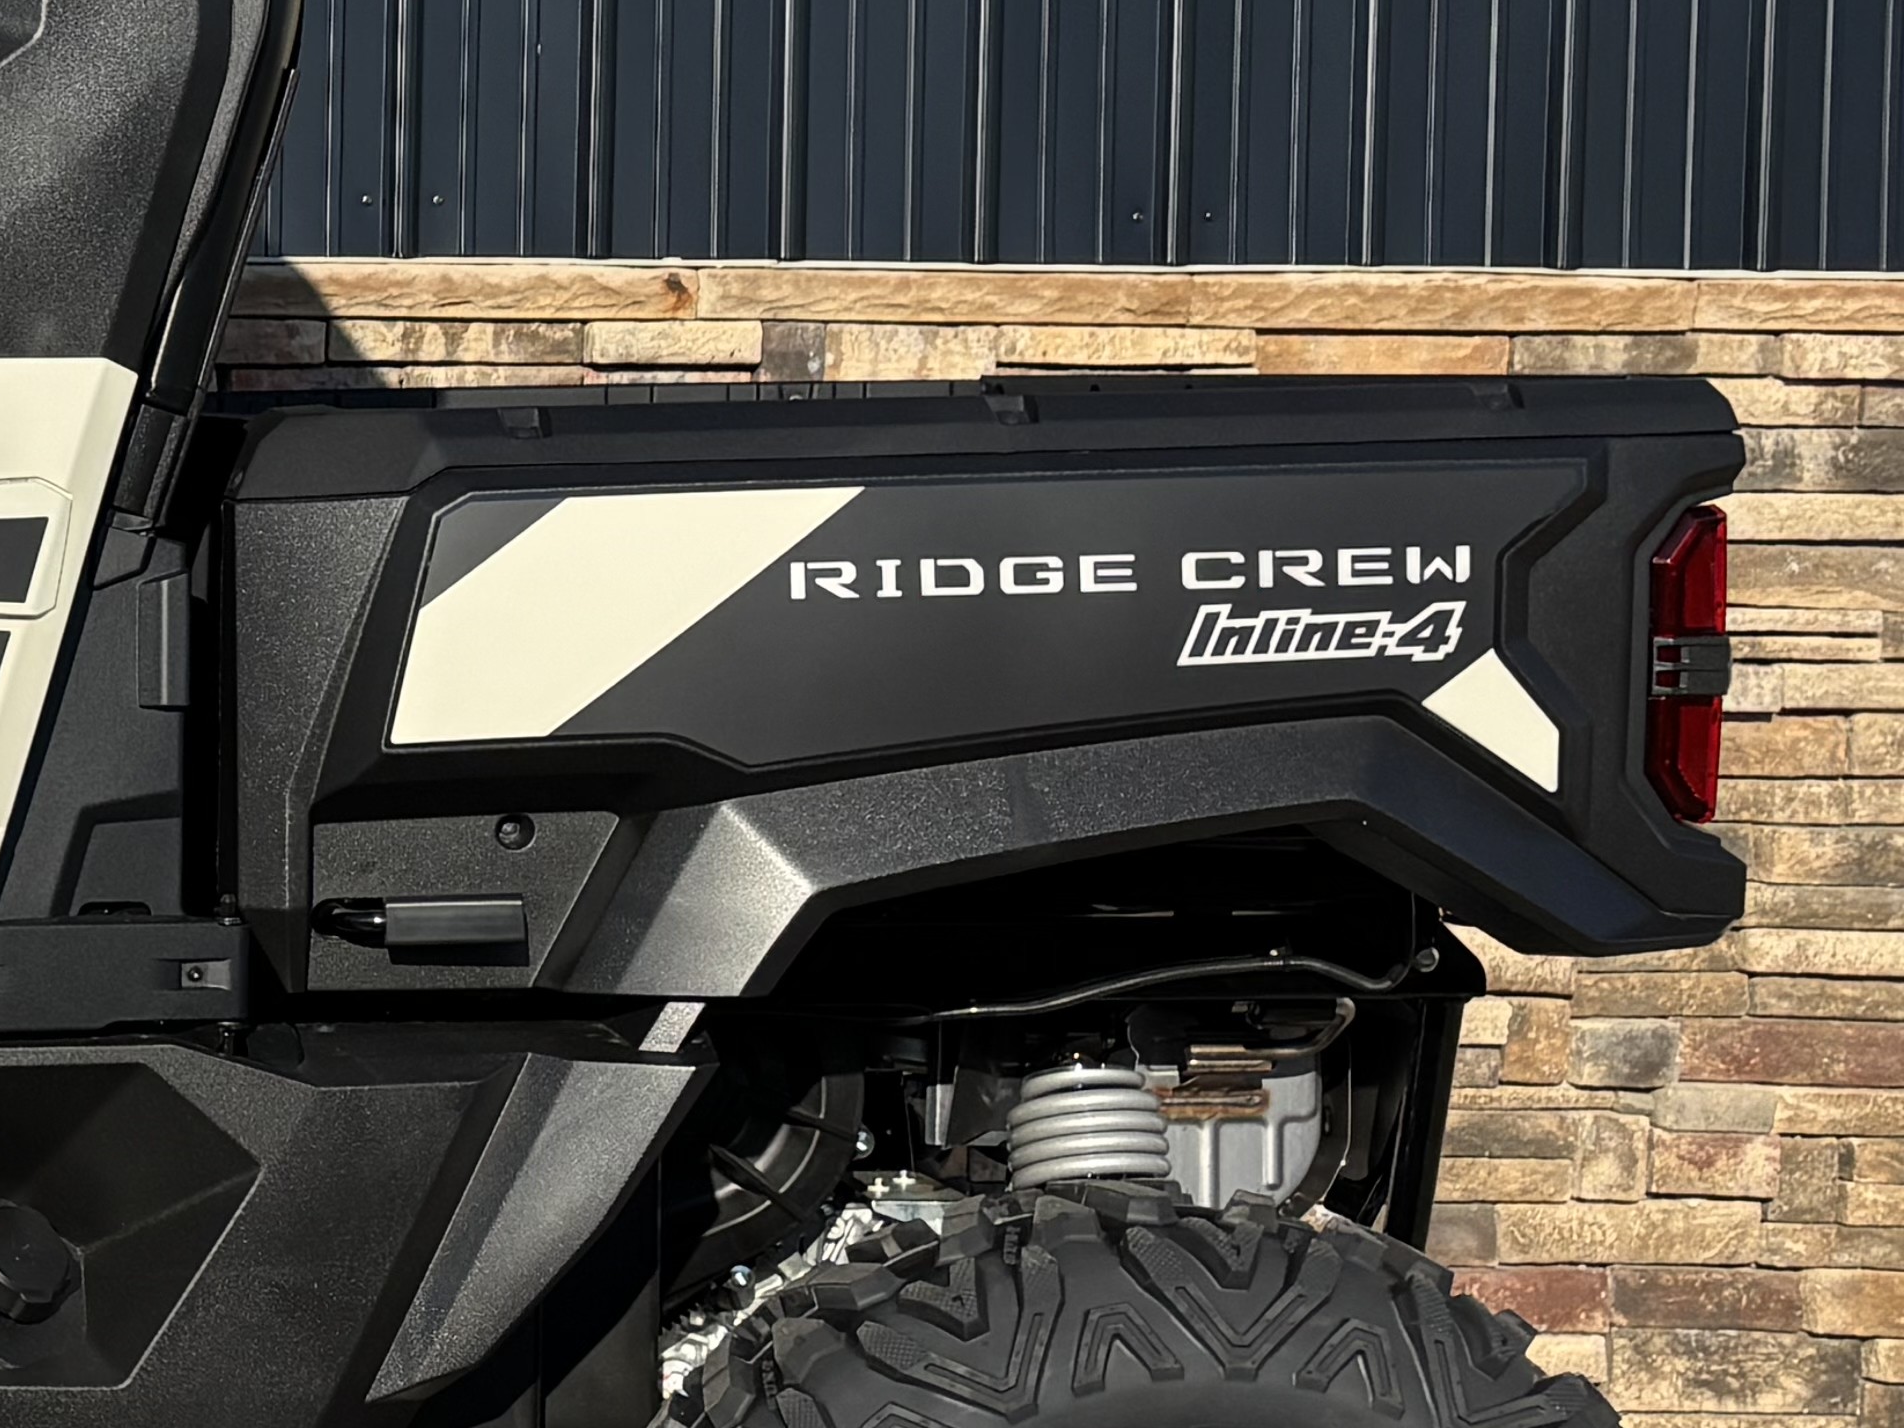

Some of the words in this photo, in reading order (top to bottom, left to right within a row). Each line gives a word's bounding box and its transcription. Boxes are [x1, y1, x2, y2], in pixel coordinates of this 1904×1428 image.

[789, 554, 1137, 600] RIDGE
[1181, 545, 1470, 590] CREW
[1177, 601, 1466, 665] Inline-4
